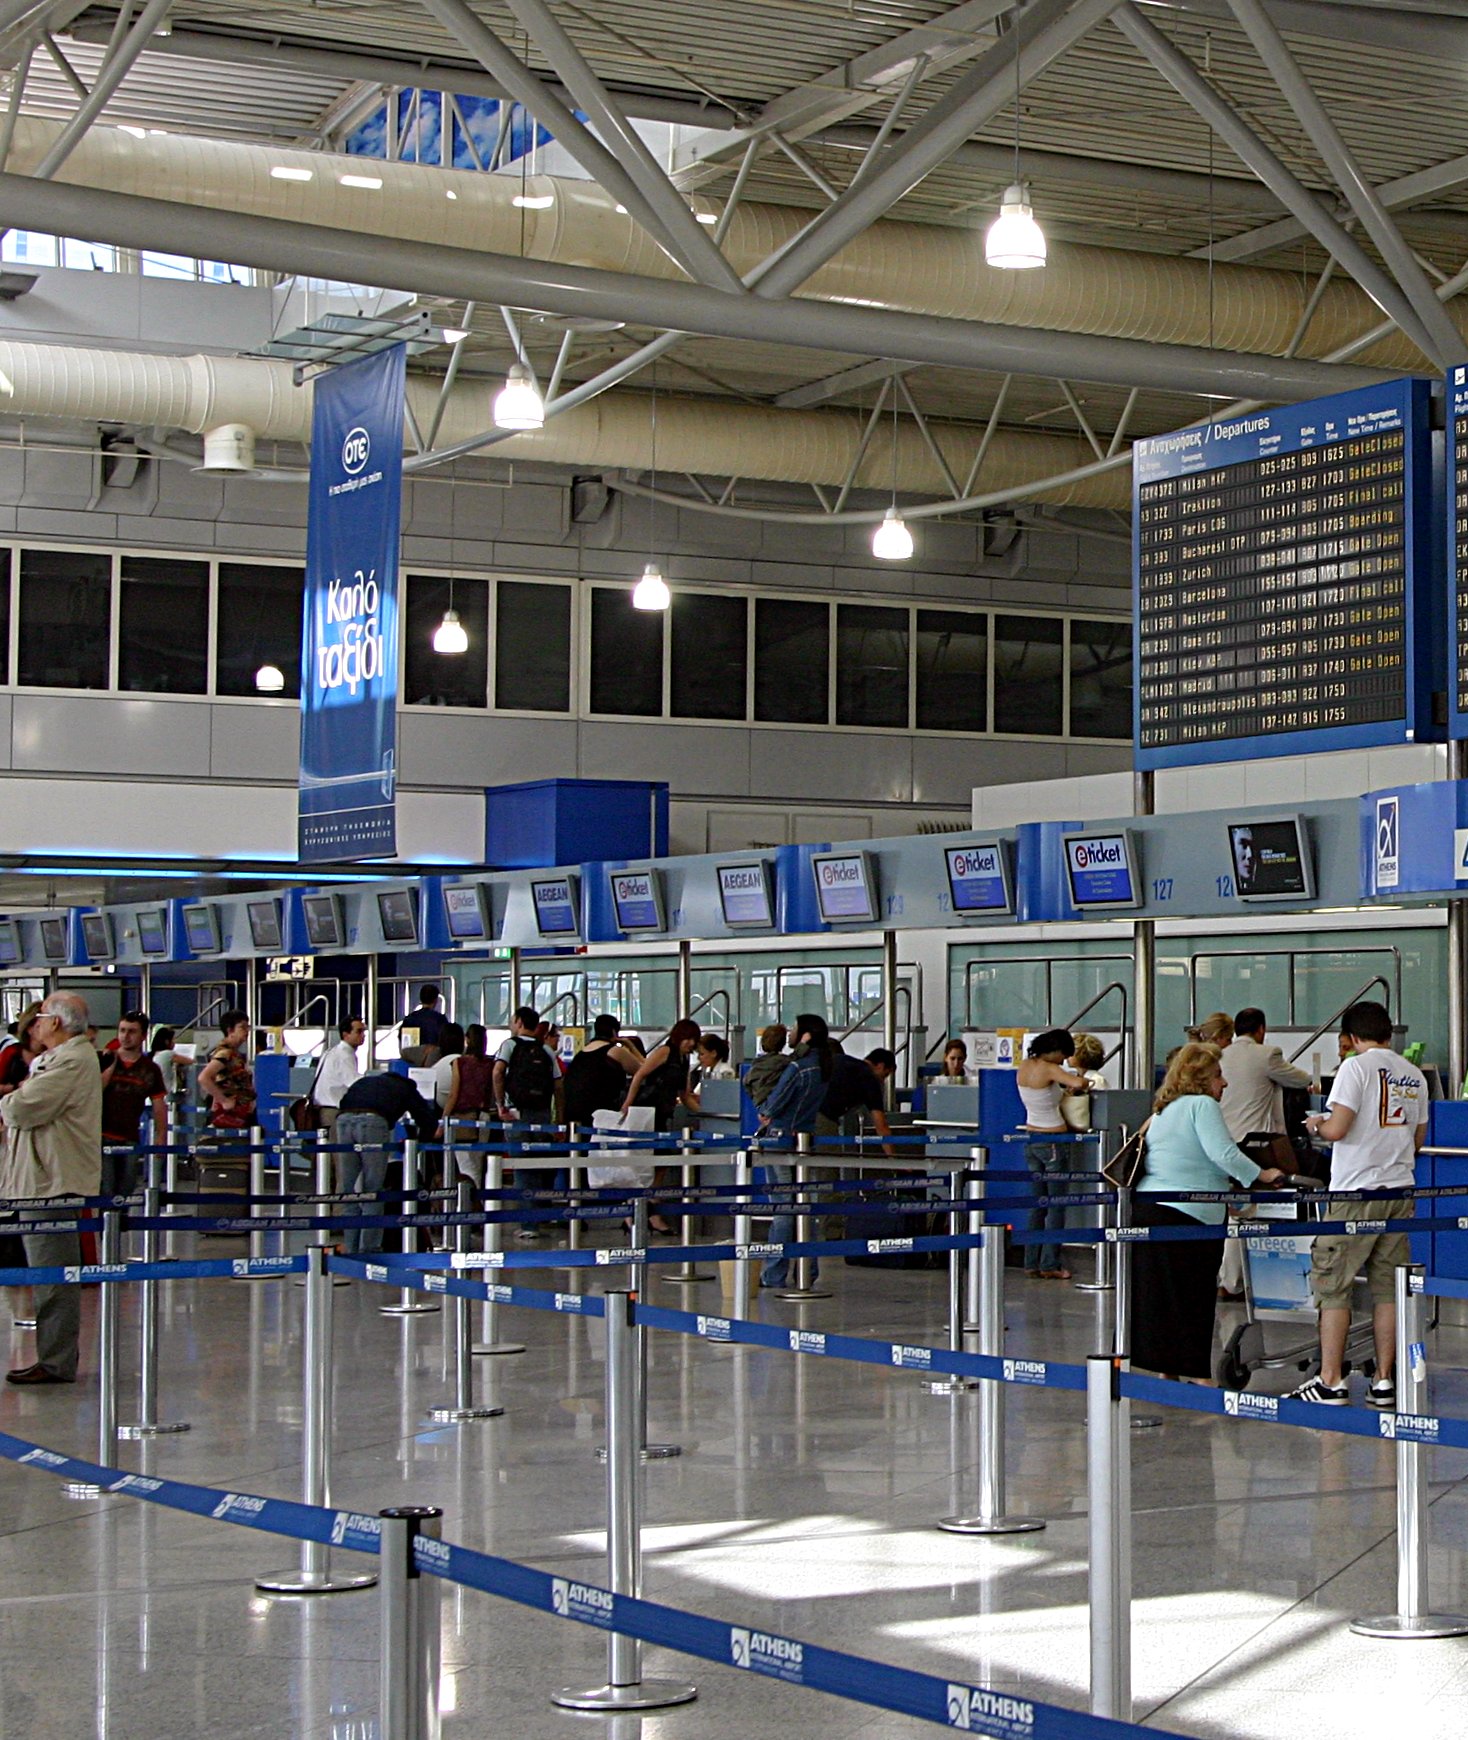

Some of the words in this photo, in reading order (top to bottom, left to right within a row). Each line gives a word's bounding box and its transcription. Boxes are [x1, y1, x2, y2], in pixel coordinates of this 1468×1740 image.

[1214, 415, 1270, 442] Departures
[327, 569, 378, 624] Καλό
[318, 617, 384, 696] ταξίδι
[724, 872, 762, 890] AEGEAN
[537, 887, 568, 903] AEGEAN
[1152, 878, 1174, 900] 127
[1118, 1227, 1150, 1236] ATHENS
[1238, 1224, 1270, 1233] ATHENS
[1357, 1220, 1386, 1230] ATHENS
[749, 1244, 784, 1252] ATHENS
[880, 1238, 913, 1247] ATHENS
[465, 1252, 504, 1262] ATHENS
[610, 1248, 646, 1257] ATHENS
[249, 1256, 292, 1266] ATHENS
[82, 1264, 127, 1274] ATHENS
[706, 1318, 730, 1330] ATHENS
[800, 1332, 826, 1344] ATHENS
[902, 1347, 932, 1360] ATHENS
[1014, 1362, 1046, 1374] ATHENS
[1238, 1394, 1278, 1410] ATHENS
[1395, 1414, 1439, 1432] ATHENS
[234, 1496, 267, 1511] ATHENS
[347, 1515, 380, 1533] ATHENS
[414, 1536, 450, 1560] ATHENS
[569, 1584, 613, 1610] ATHENS
[751, 1633, 803, 1662] ATHENS
[970, 1690, 1034, 1724] ATHENS
